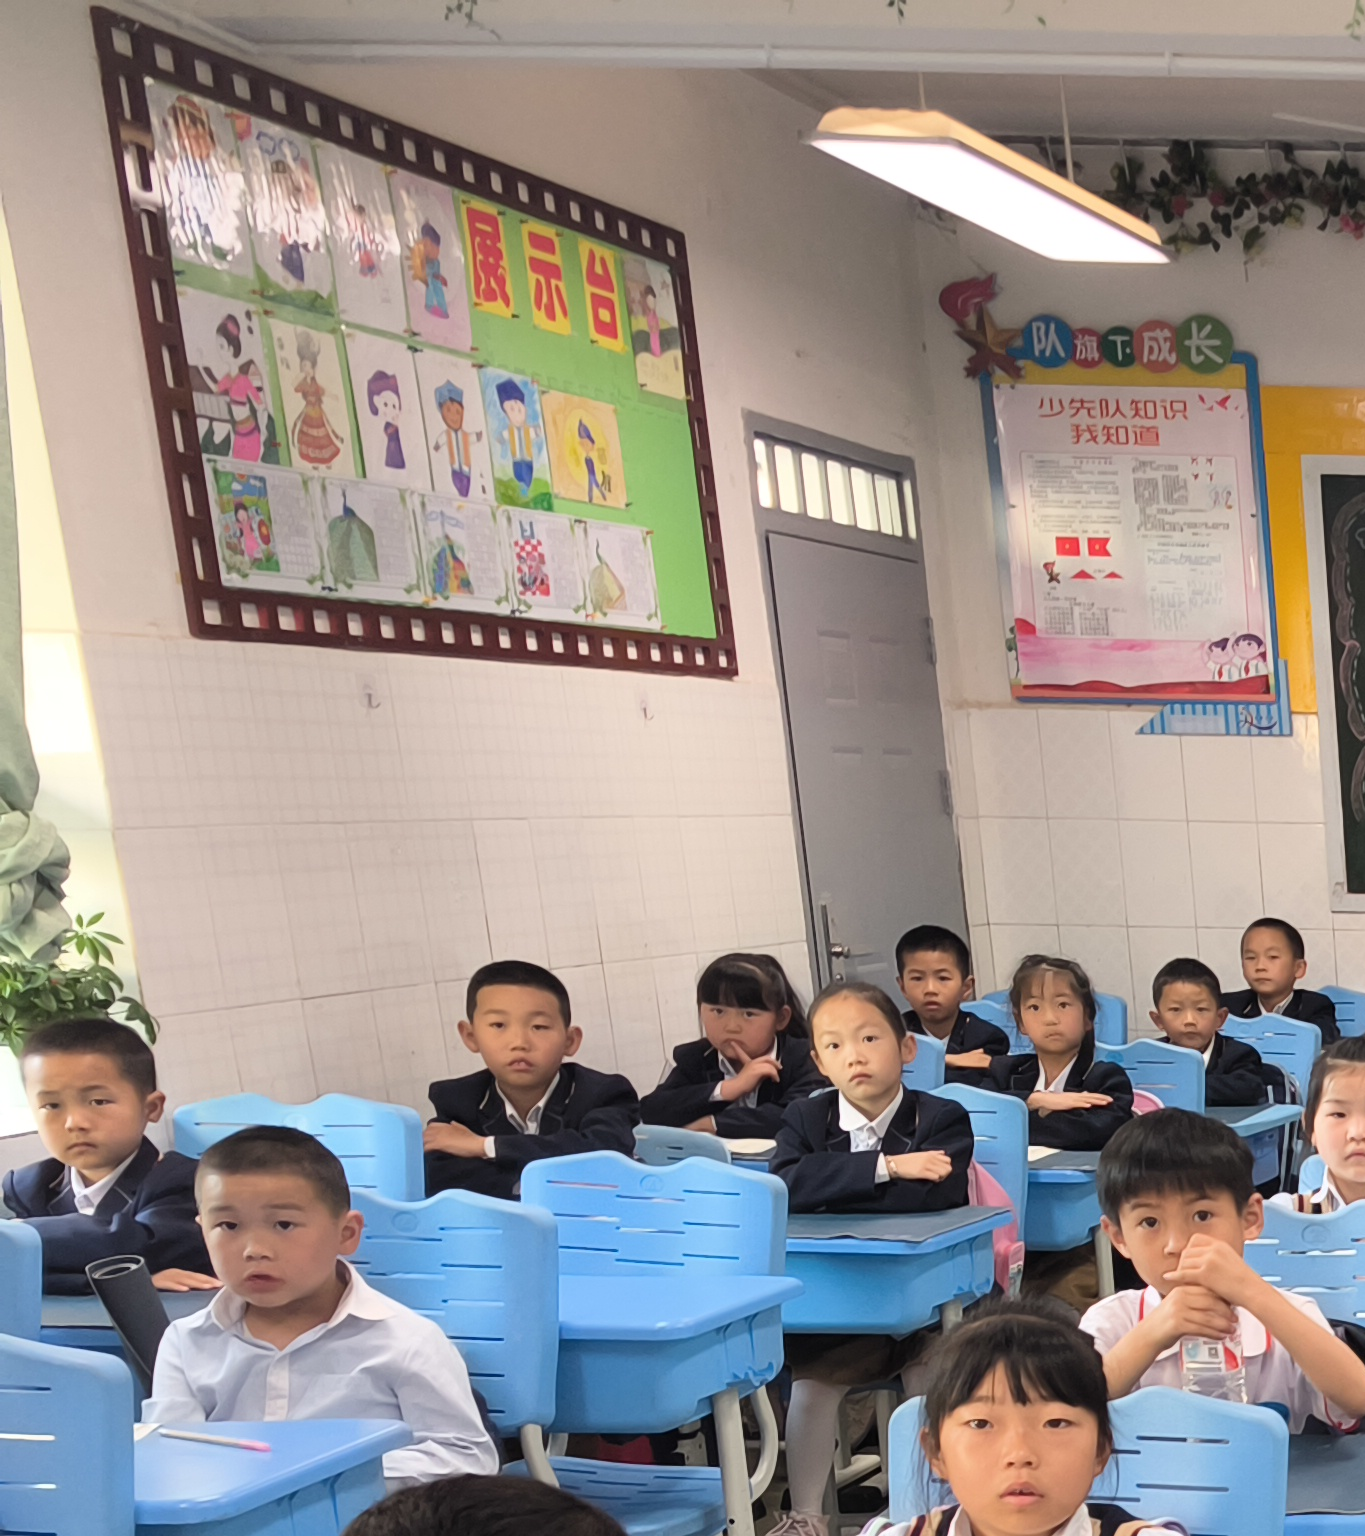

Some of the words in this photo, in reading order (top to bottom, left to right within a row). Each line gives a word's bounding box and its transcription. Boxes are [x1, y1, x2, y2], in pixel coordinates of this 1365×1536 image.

[465, 206, 620, 341] 展示台
[1030, 322, 1223, 366] 队旗下成长
[1038, 396, 1190, 421] 少先队知识
[1070, 422, 1161, 446] 我知道
